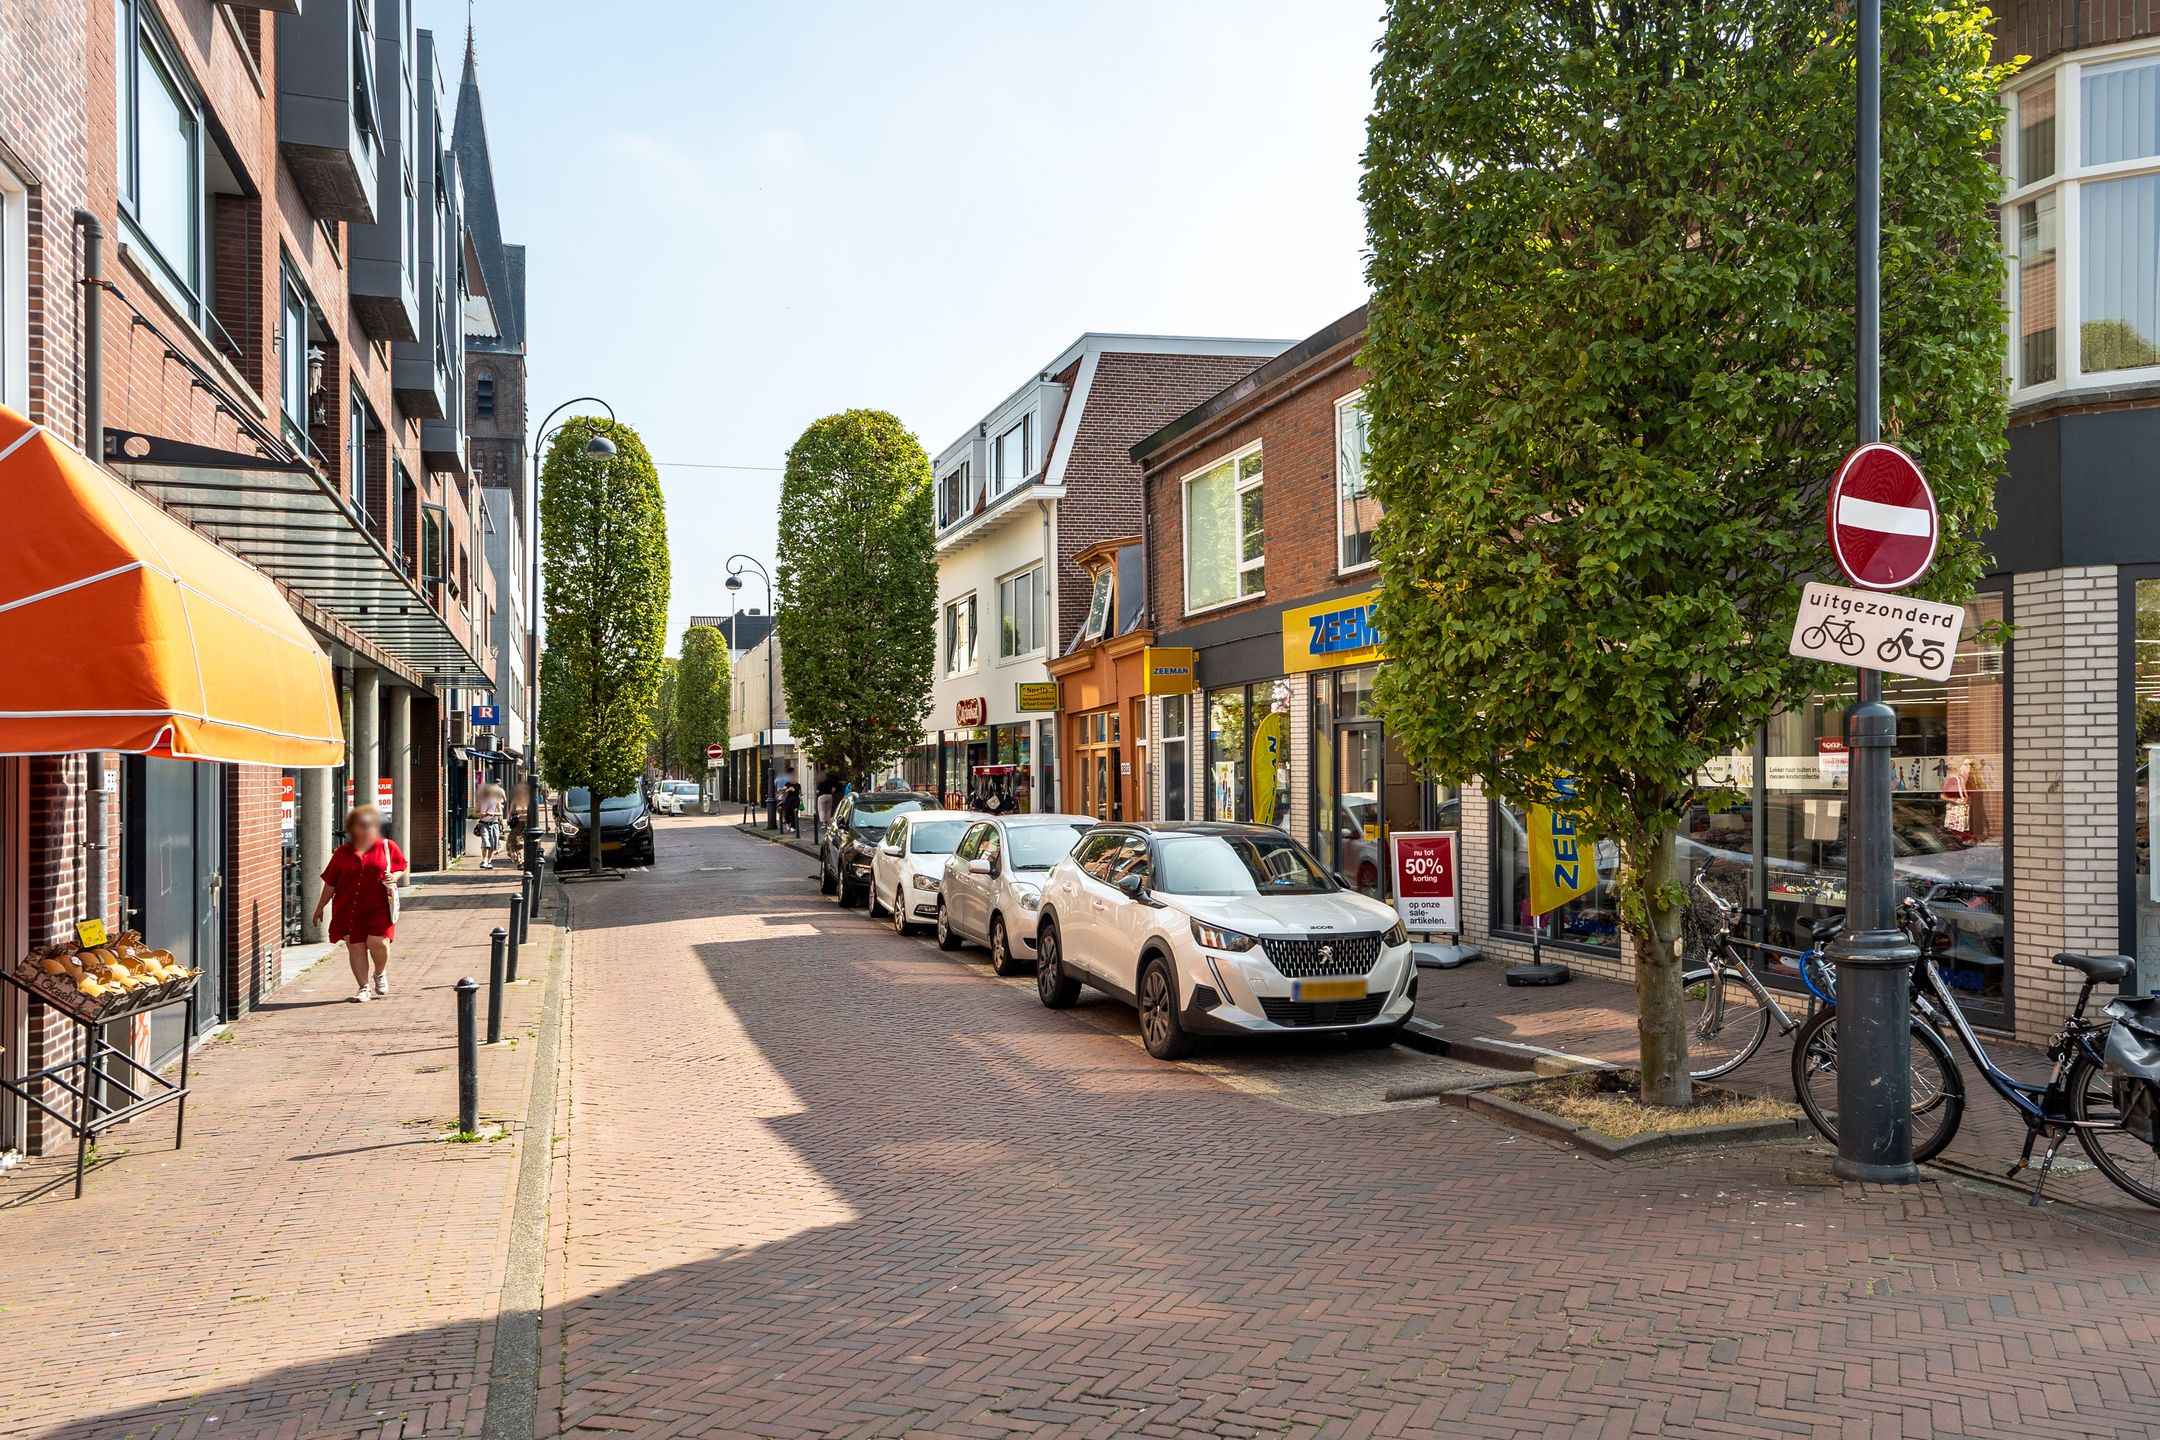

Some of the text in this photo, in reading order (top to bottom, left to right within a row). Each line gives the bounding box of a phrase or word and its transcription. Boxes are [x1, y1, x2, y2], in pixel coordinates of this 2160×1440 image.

[1810, 593, 1954, 628] uitgezonderd
[1308, 604, 1386, 655] ZEEM
[1153, 667, 1189, 675] ZEEMAN
[1551, 776, 1579, 890] ZEEM
[1405, 858, 1444, 875] 50%
[1413, 875, 1438, 883] korting
[1409, 917, 1447, 925] artikelen.
